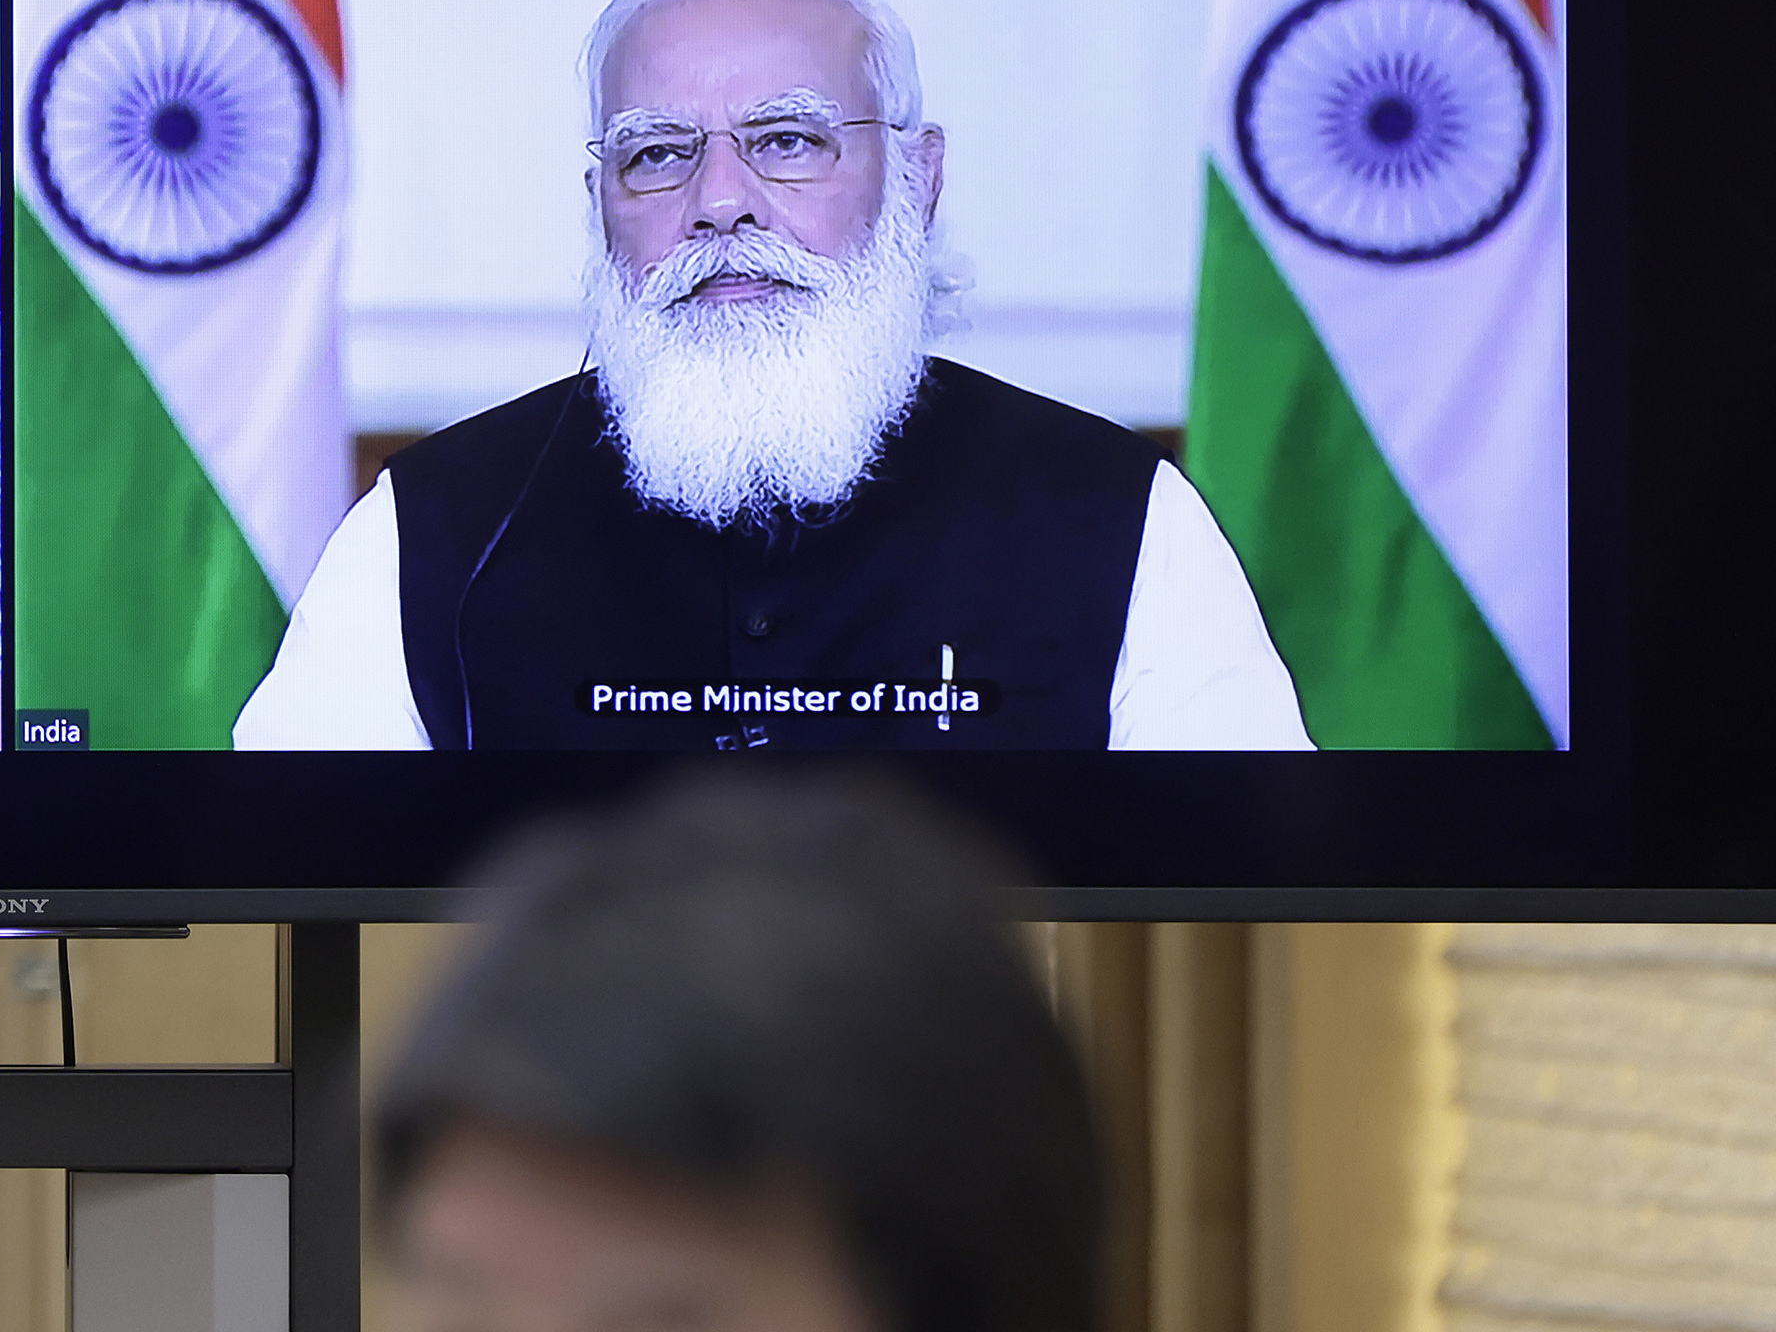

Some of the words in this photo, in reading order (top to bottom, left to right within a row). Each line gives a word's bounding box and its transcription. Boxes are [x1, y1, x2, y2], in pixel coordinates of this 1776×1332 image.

[592, 684, 693, 712] Prime
[703, 684, 841, 713] Minister
[850, 683, 886, 712] of
[893, 684, 980, 712] India
[23, 718, 81, 743] India
